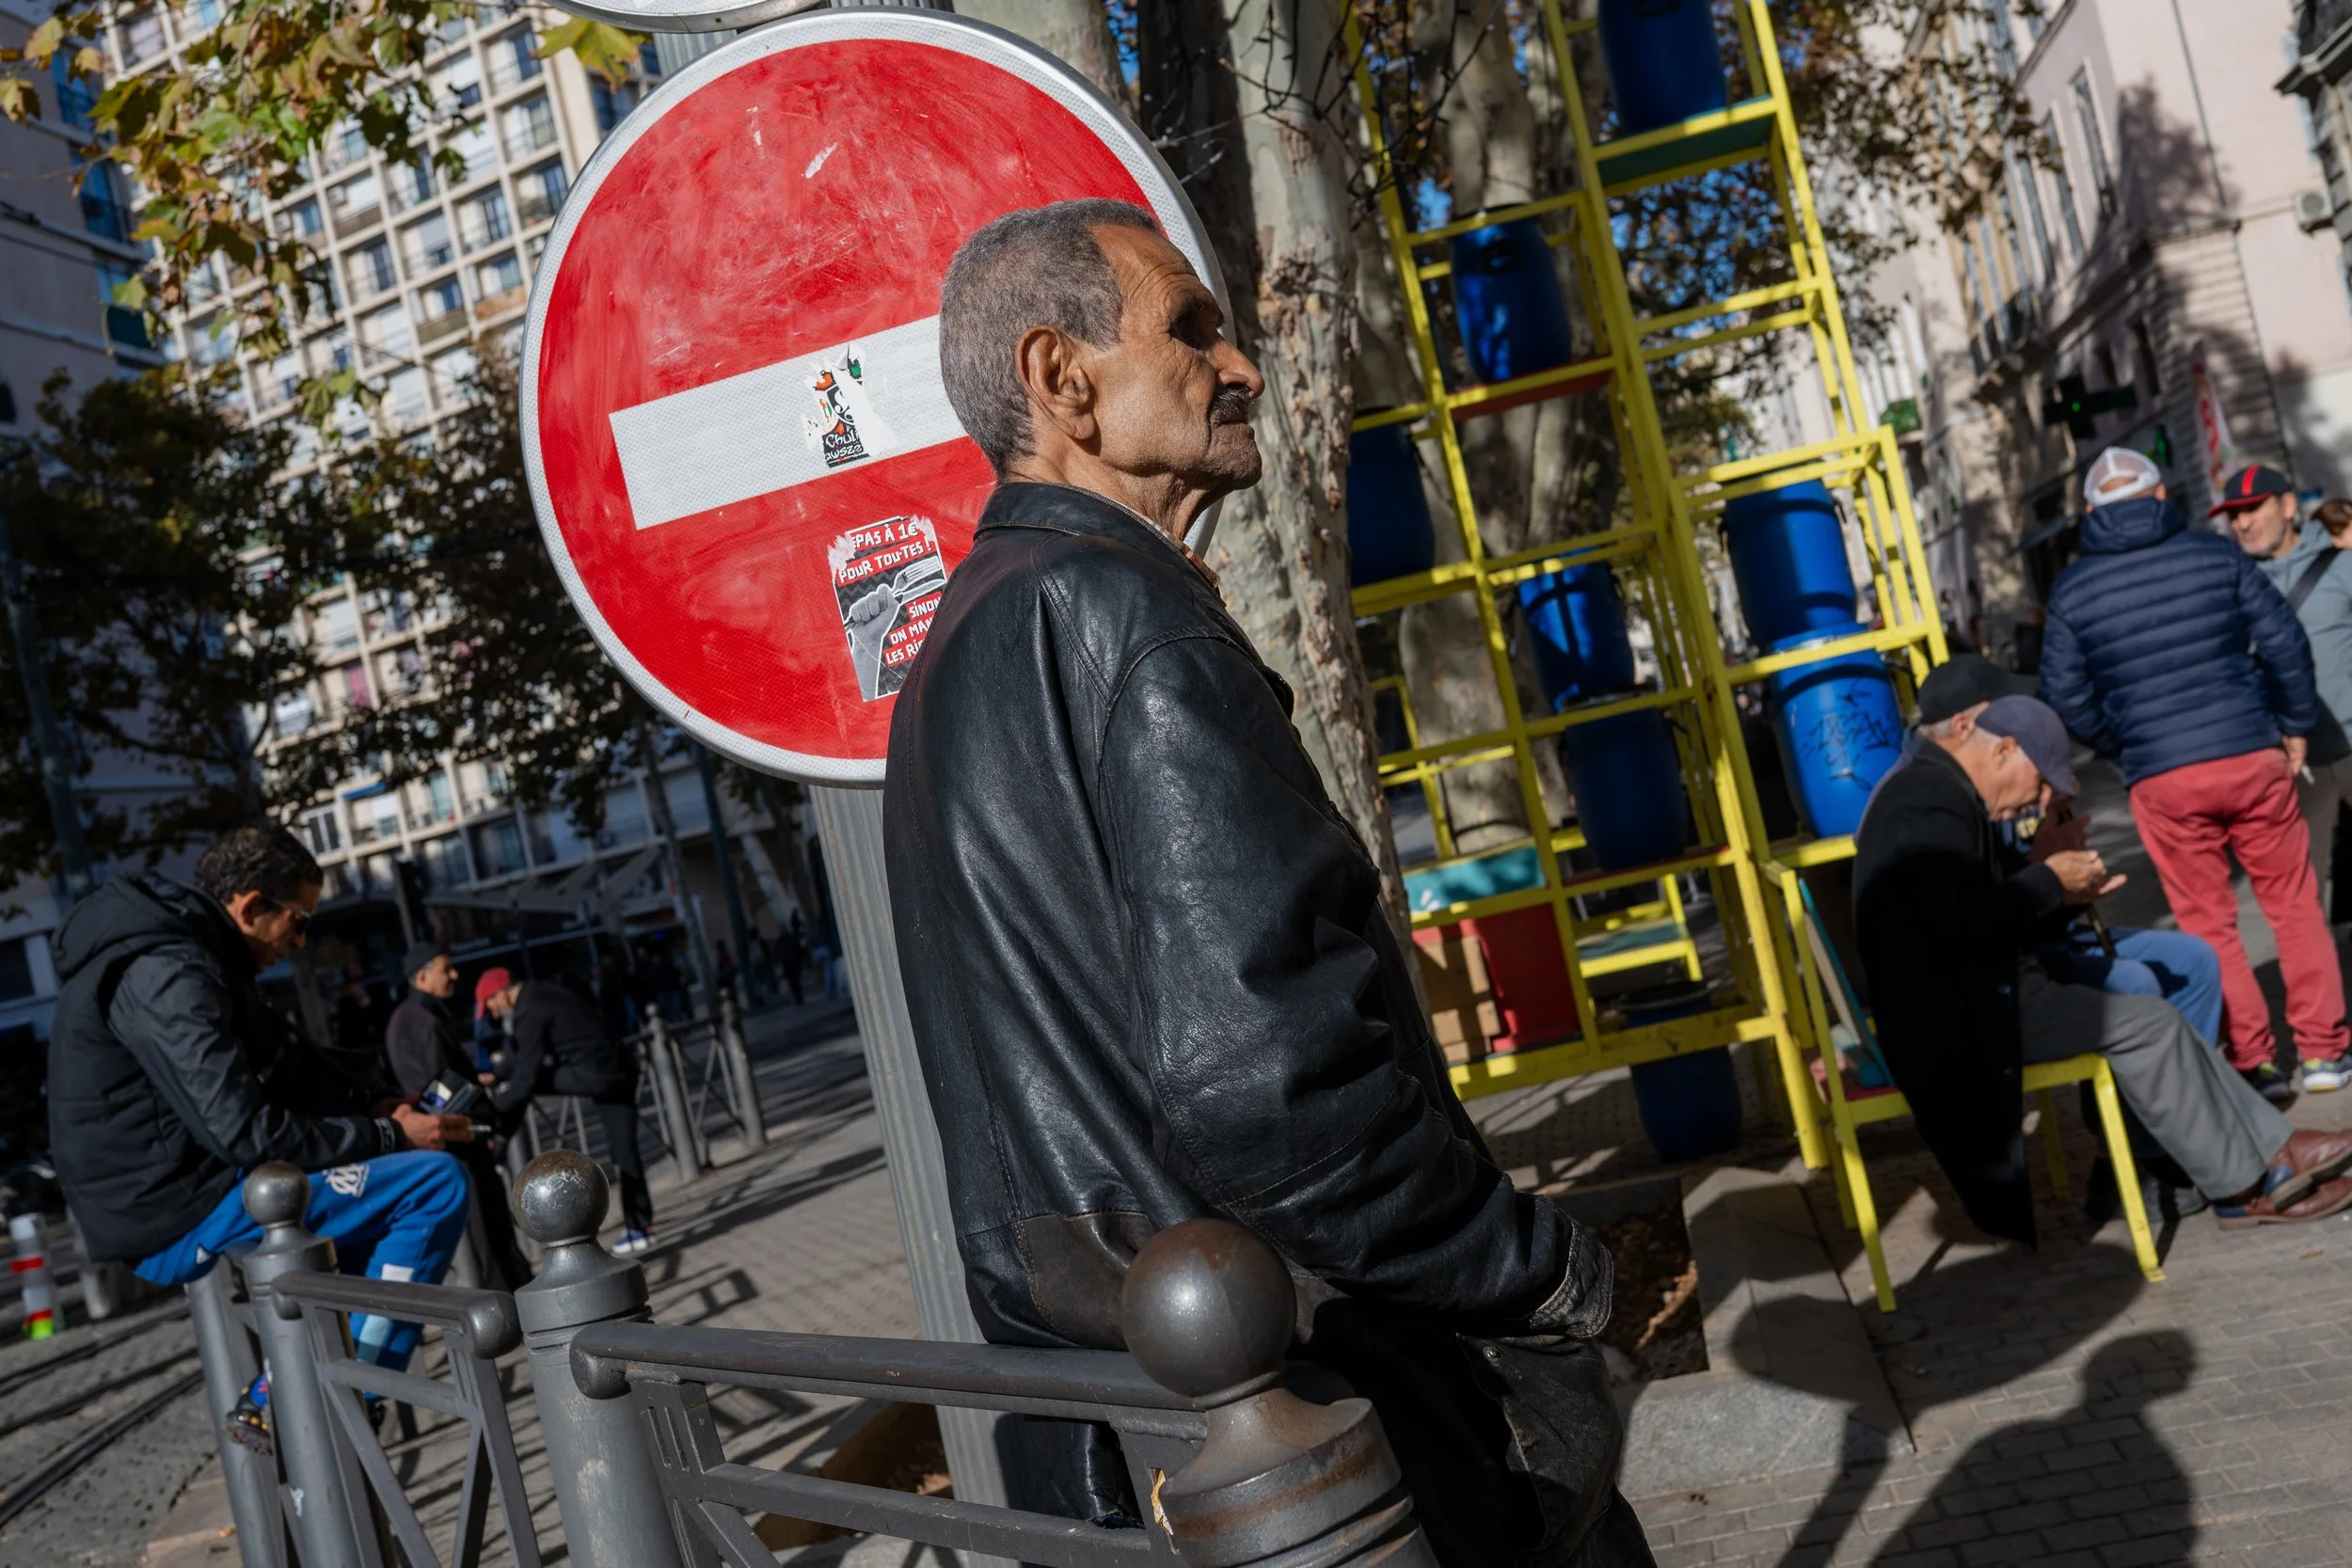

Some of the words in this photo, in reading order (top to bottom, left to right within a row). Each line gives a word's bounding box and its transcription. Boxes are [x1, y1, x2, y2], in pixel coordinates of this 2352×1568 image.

[884, 523, 896, 542] À
[838, 560, 874, 583] POUR
[890, 629, 908, 645] ON
[885, 648, 905, 664] LES
